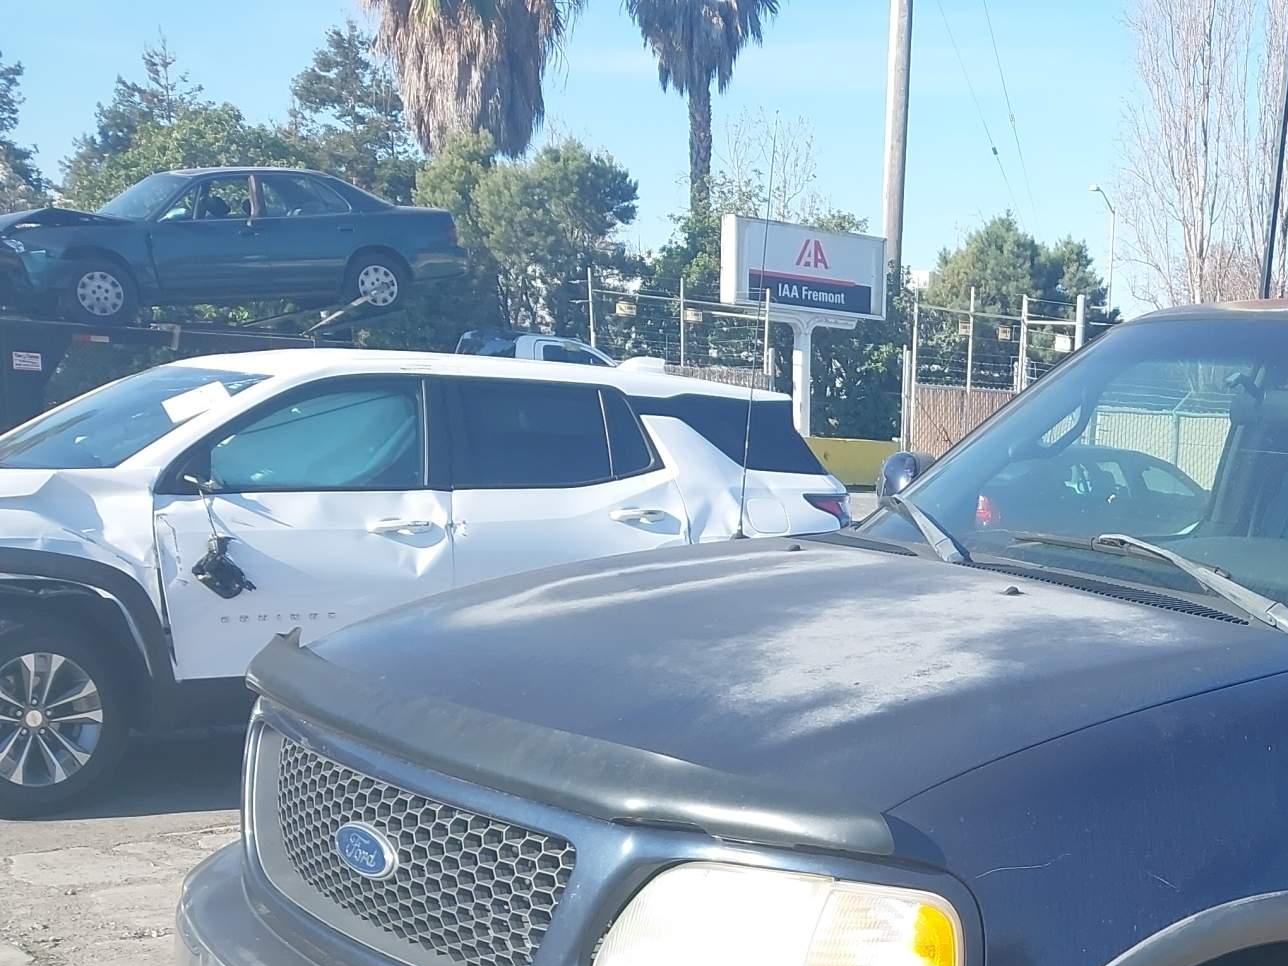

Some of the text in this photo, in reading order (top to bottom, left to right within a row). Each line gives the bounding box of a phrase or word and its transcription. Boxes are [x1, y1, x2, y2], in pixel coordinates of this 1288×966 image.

[778, 282, 846, 305] IAA Fremont
[345, 832, 377, 867] Ford
